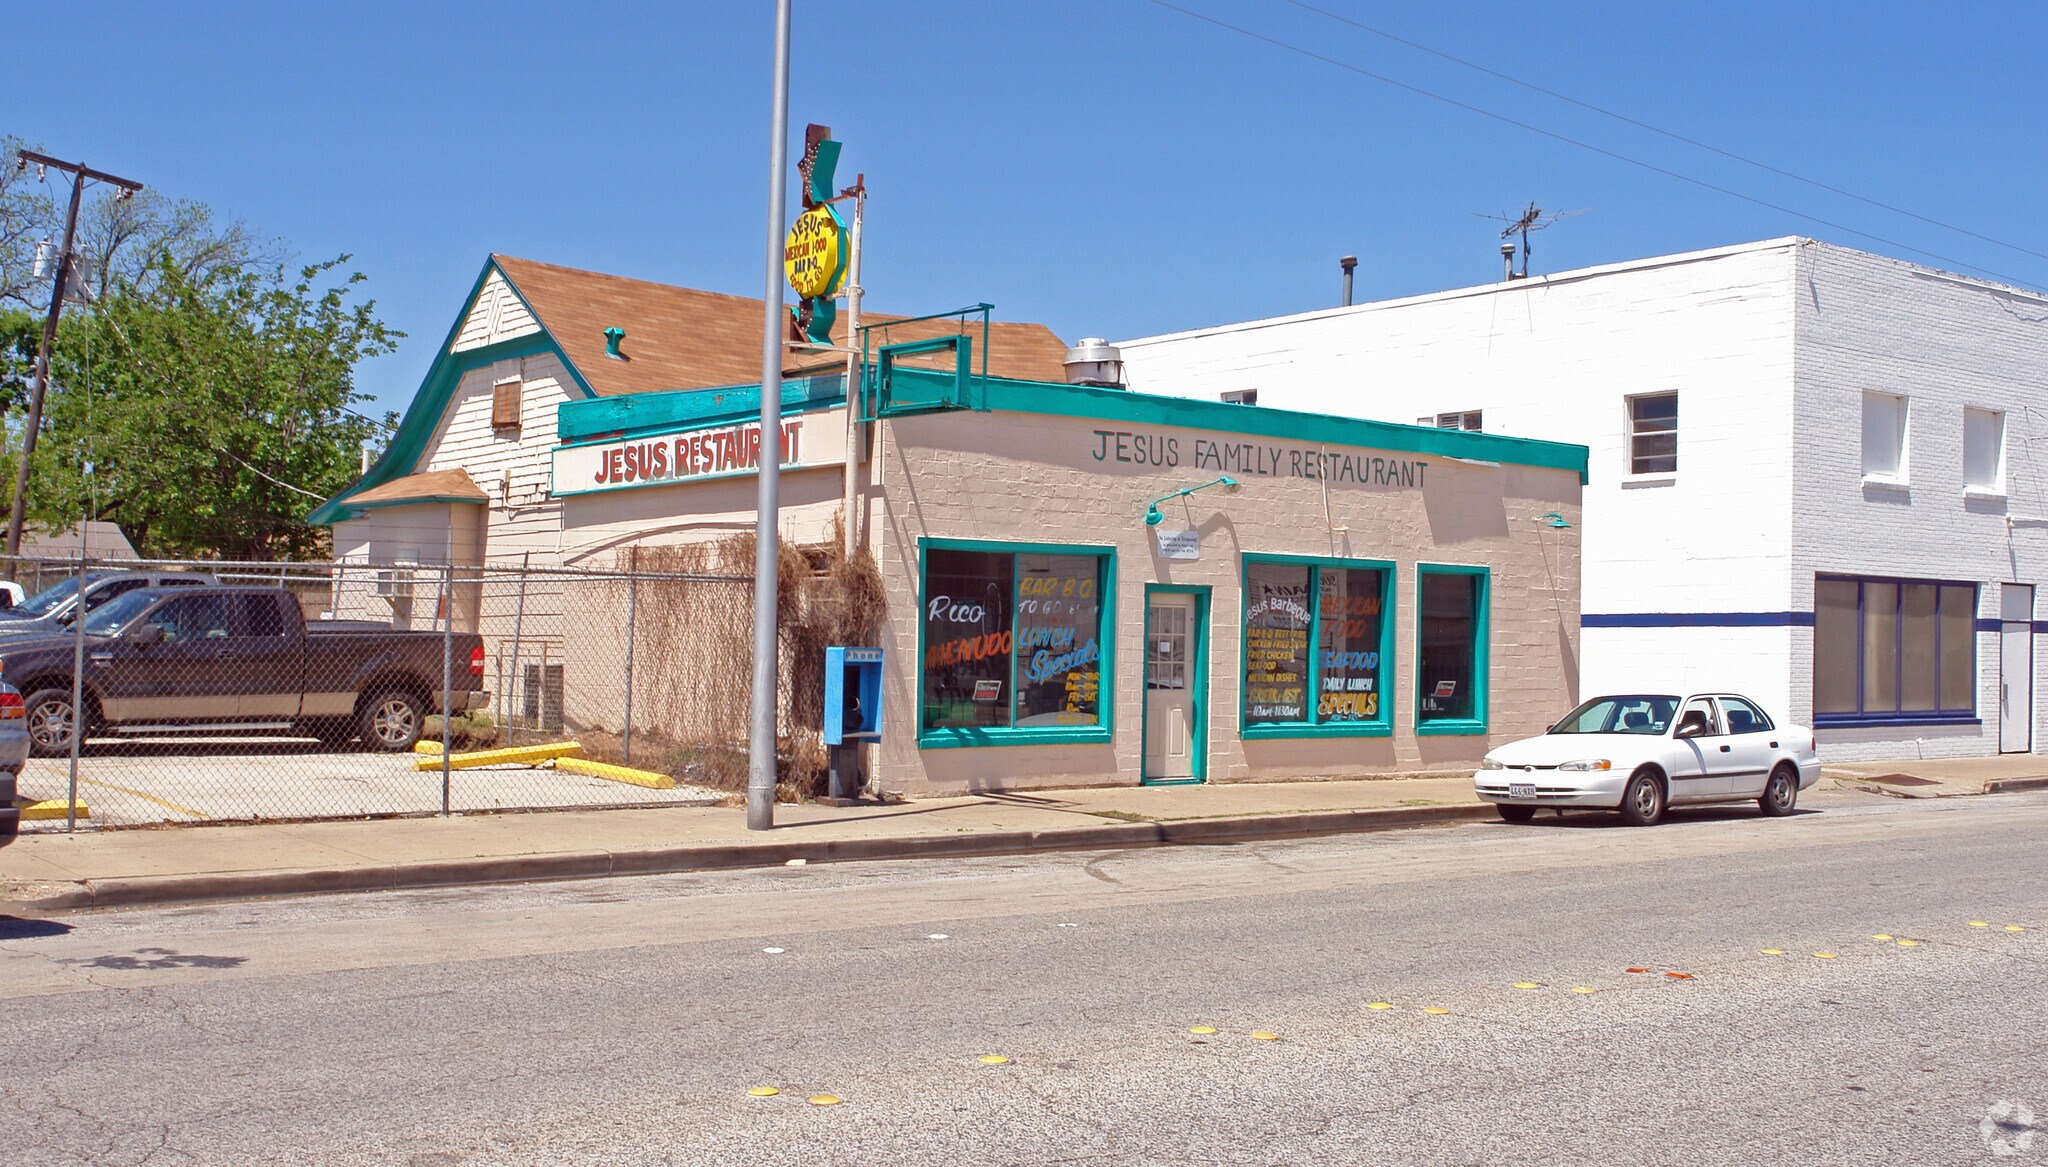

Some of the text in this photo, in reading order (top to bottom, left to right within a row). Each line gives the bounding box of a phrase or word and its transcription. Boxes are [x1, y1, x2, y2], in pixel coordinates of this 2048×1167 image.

[792, 213, 823, 243] JESUS
[785, 242, 810, 262] MEXICAN
[806, 278, 814, 292] TO
[815, 266, 823, 281] GO
[594, 421, 804, 484] JESUS RESTAURNT
[1092, 429, 1429, 489] JESUS FAMILY RESTAURANT
[1020, 577, 1059, 597] BAR
[929, 595, 985, 623] Rico
[1018, 600, 1039, 614] TO
[1042, 600, 1062, 615] GO
[1270, 597, 1312, 624] Barbeque
[1320, 595, 1382, 616] MEXICAN
[1018, 626, 1076, 649] LUNCH
[1324, 619, 1367, 638] FOOD
[845, 651, 881, 660] Phone
[924, 630, 1014, 672] MENUDO
[1024, 638, 1101, 686] Specials
[1317, 651, 1379, 670] SEAFOOD
[1247, 661, 1278, 671] SEAFOOD
[1276, 672, 1297, 683] DISHES
[1322, 676, 1373, 691] DAILY LUNCH
[1317, 692, 1378, 718] SPECIALS
